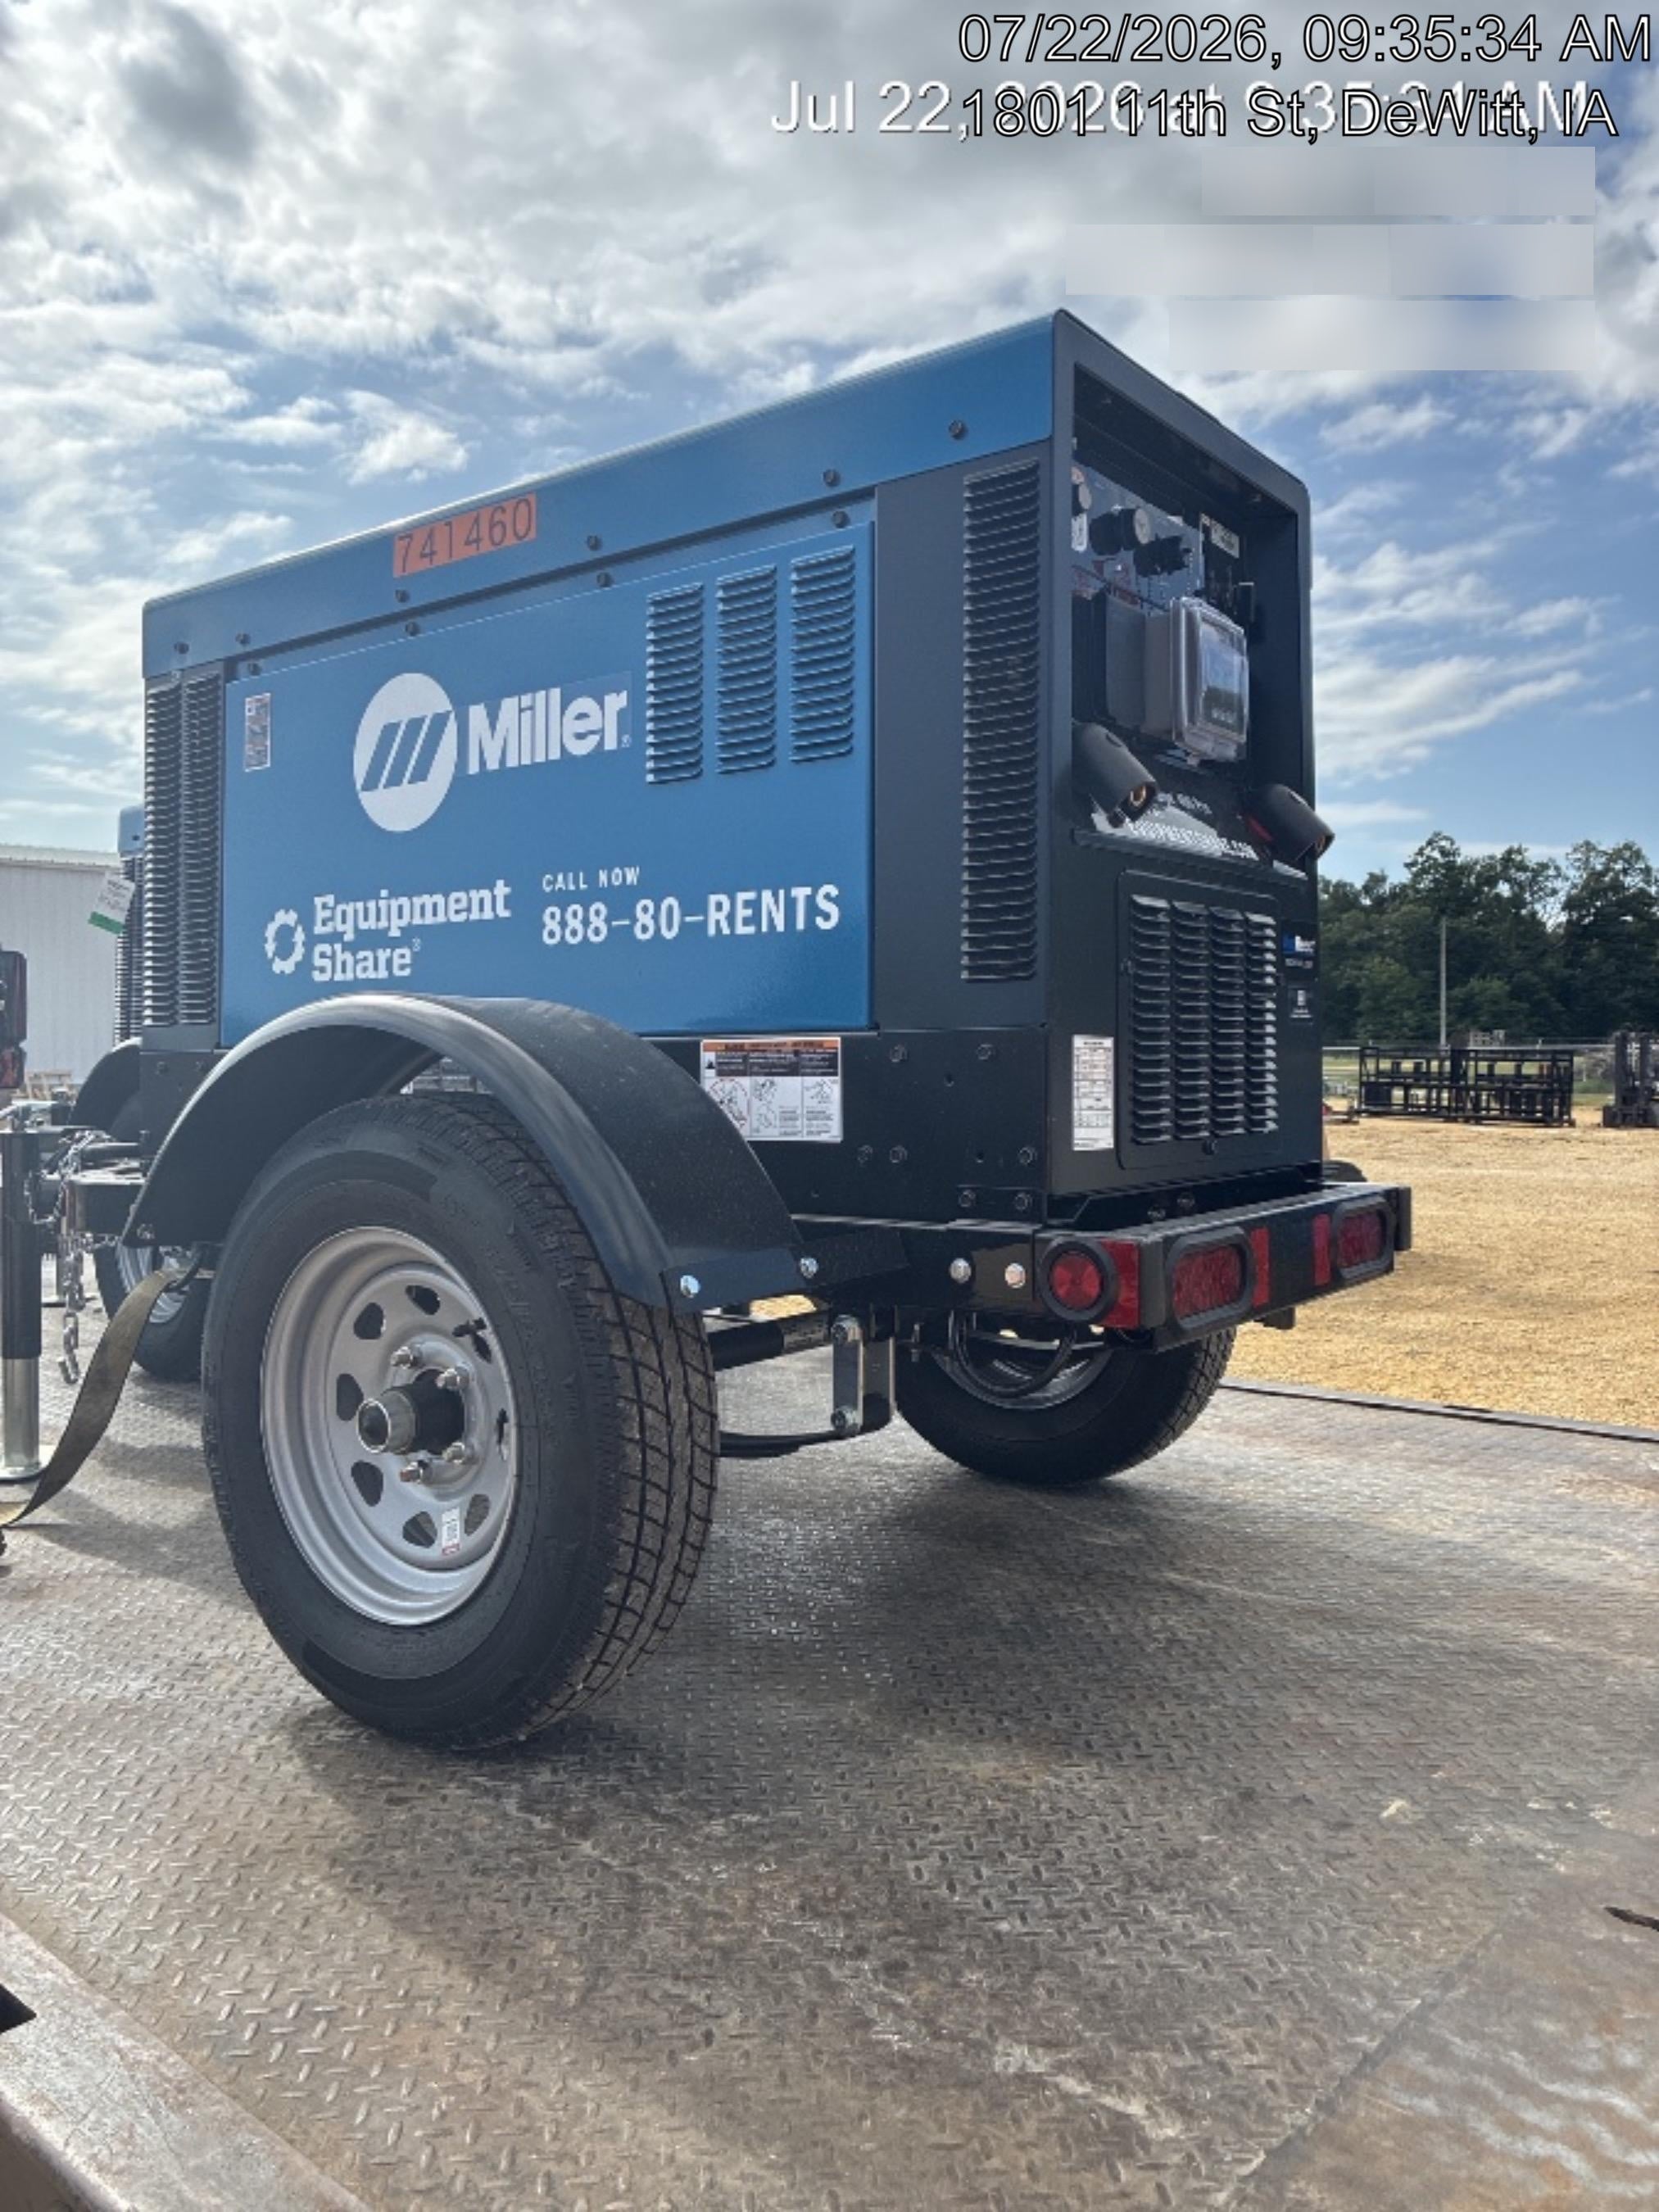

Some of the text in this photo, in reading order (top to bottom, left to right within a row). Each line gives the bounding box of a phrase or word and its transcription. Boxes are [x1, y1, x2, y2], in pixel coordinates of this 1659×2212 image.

[397, 496, 533, 573] 741460
[467, 687, 628, 775] Miller
[313, 879, 511, 941] Equipment
[542, 866, 641, 893] CALL NOW
[542, 884, 840, 945] 888-80-RENTS
[311, 943, 412, 982] Share
